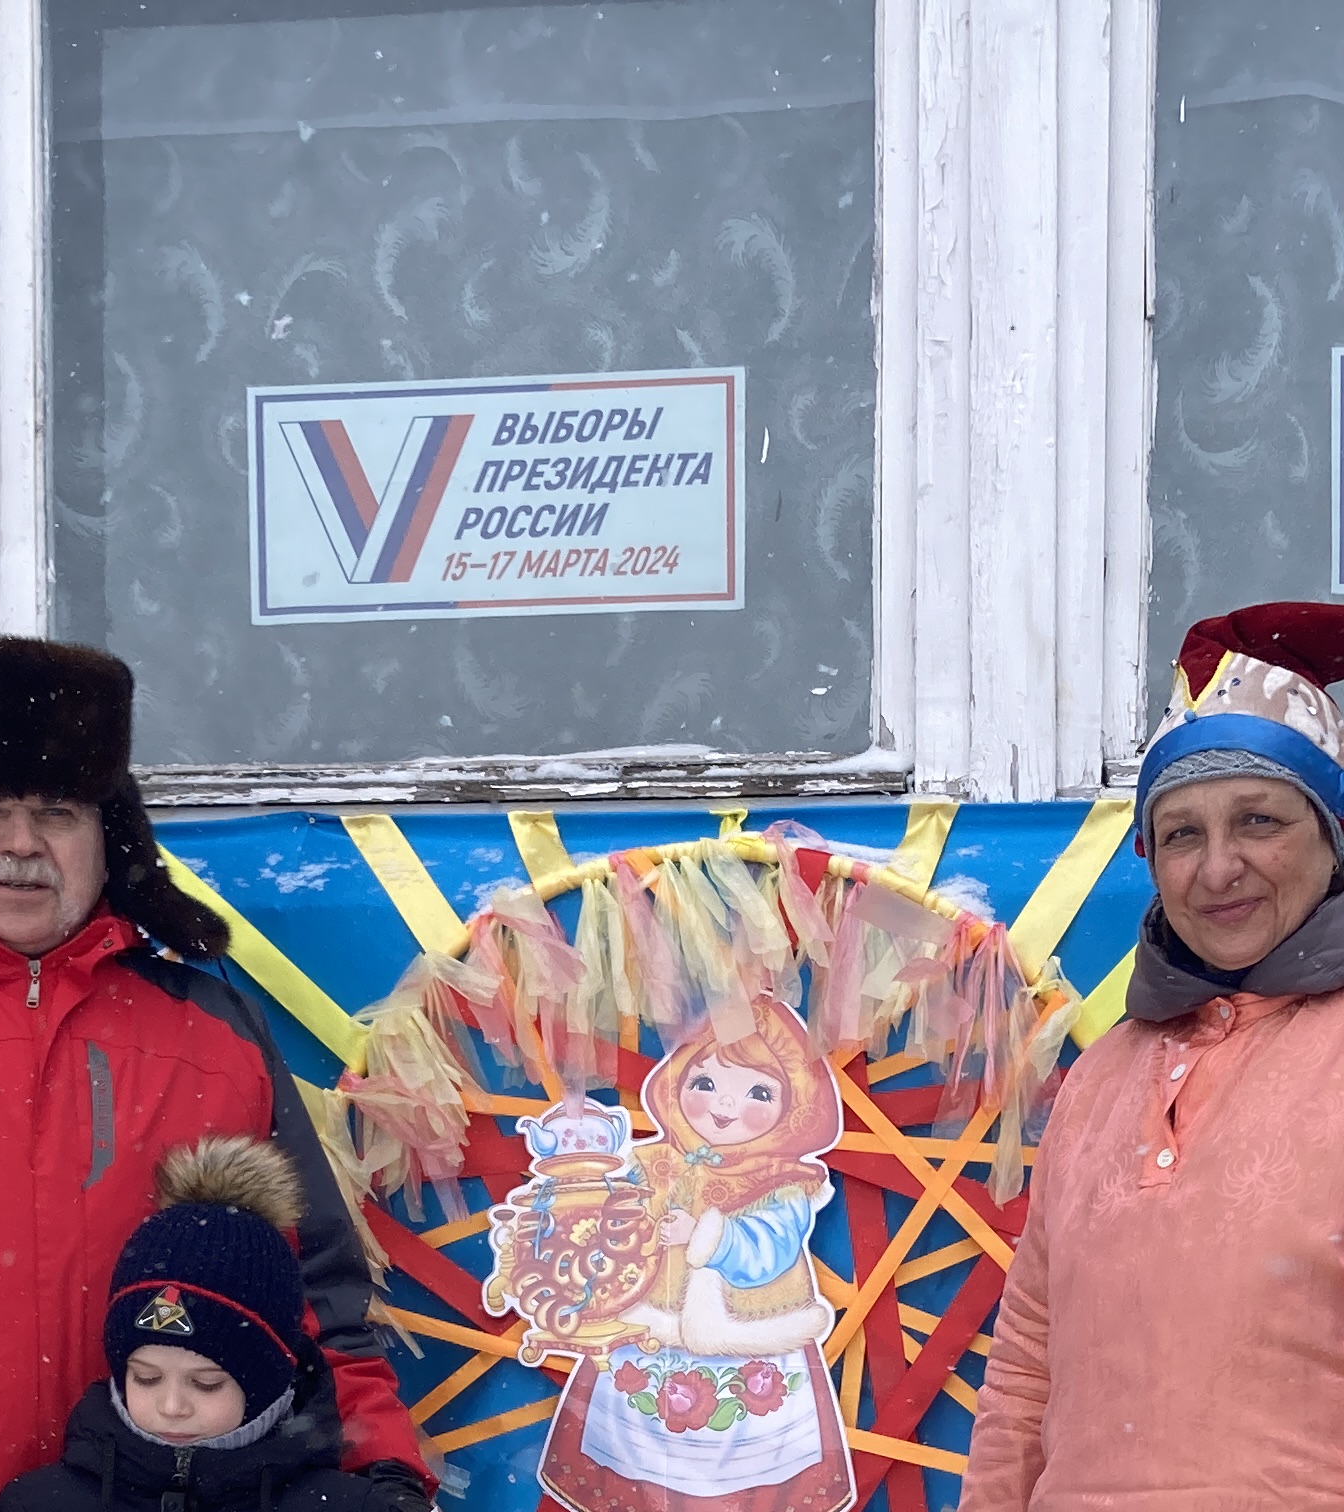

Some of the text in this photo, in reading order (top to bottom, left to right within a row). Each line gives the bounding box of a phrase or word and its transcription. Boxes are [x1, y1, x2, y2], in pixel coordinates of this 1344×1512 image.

[492, 407, 664, 446] ВЫБОРЫ
[473, 452, 713, 494] ПРЕЗИДЕНТА
[454, 502, 610, 540] РОССИИ
[518, 548, 608, 580] МАРТА
[612, 545, 680, 576] 2024
